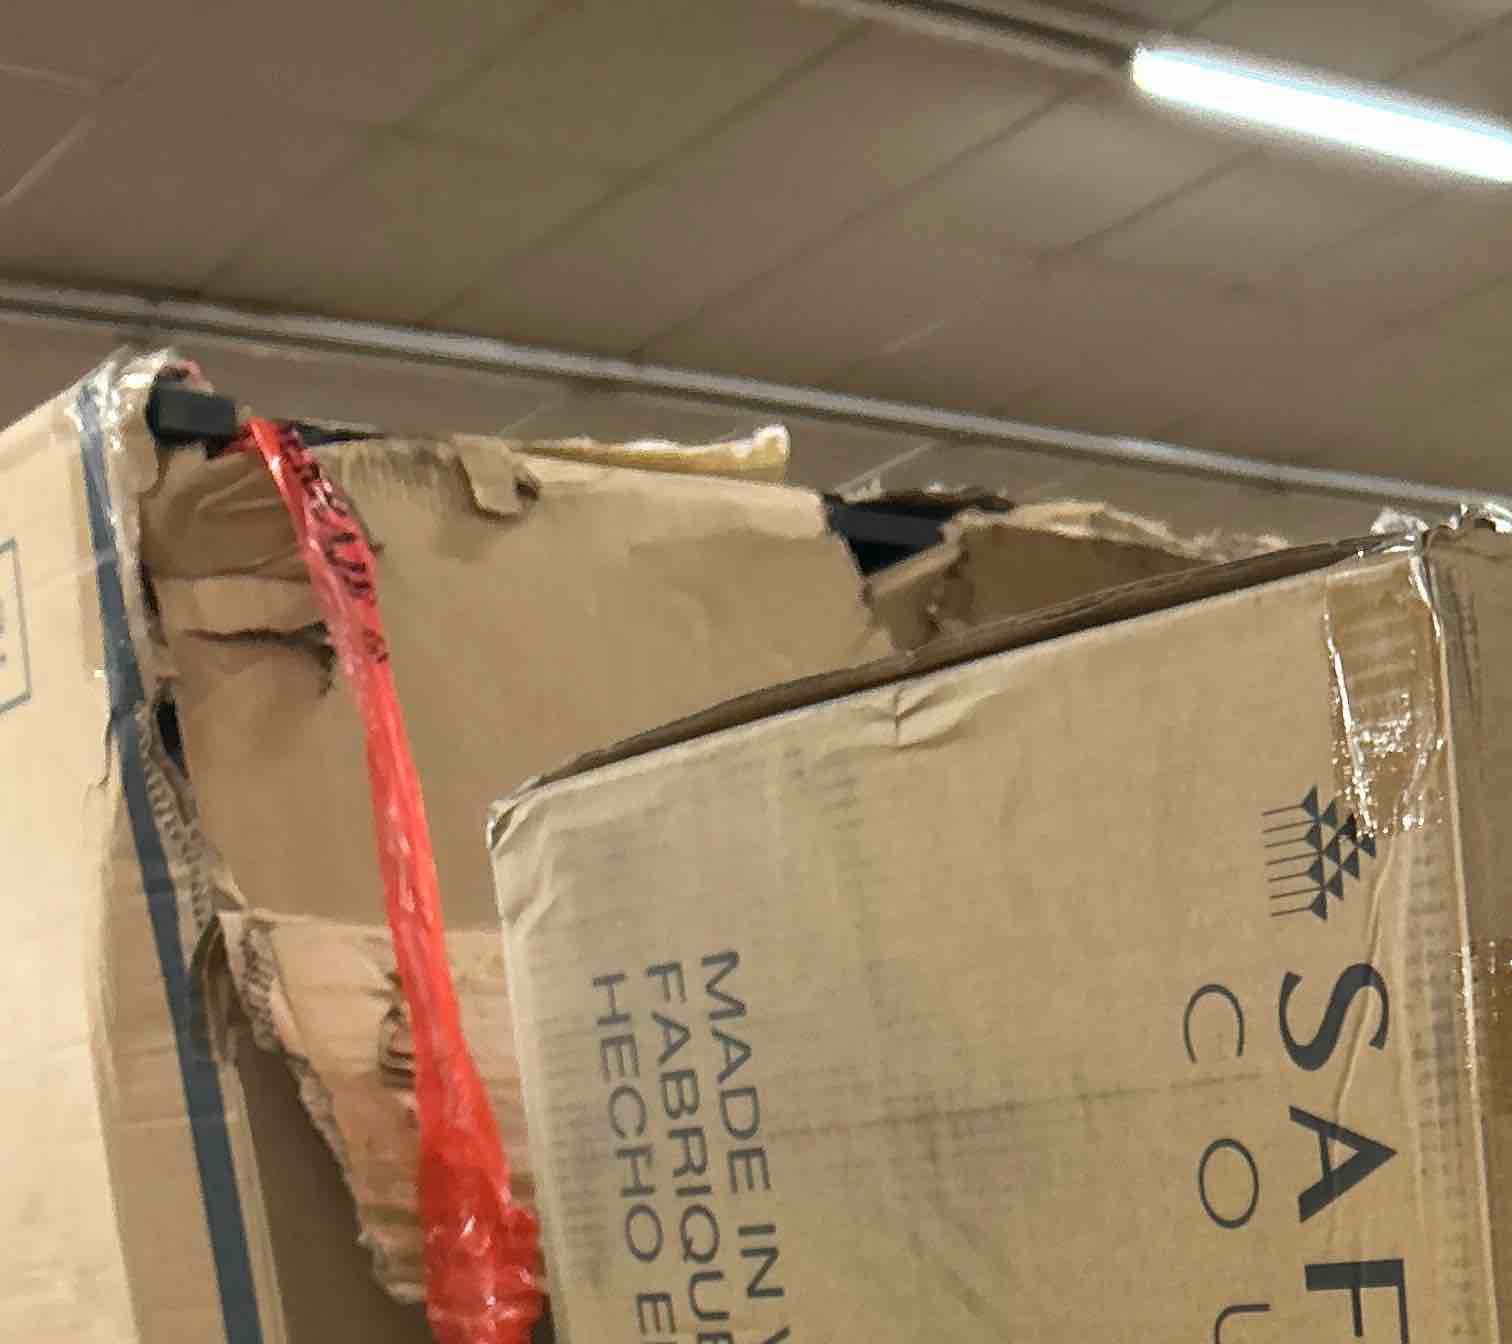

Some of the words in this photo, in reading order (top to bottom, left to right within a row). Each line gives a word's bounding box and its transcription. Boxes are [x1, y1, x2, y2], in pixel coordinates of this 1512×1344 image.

[592, 972, 666, 1264] HECHO
[702, 949, 773, 1194] MADE
[737, 1222, 786, 1300] IN
